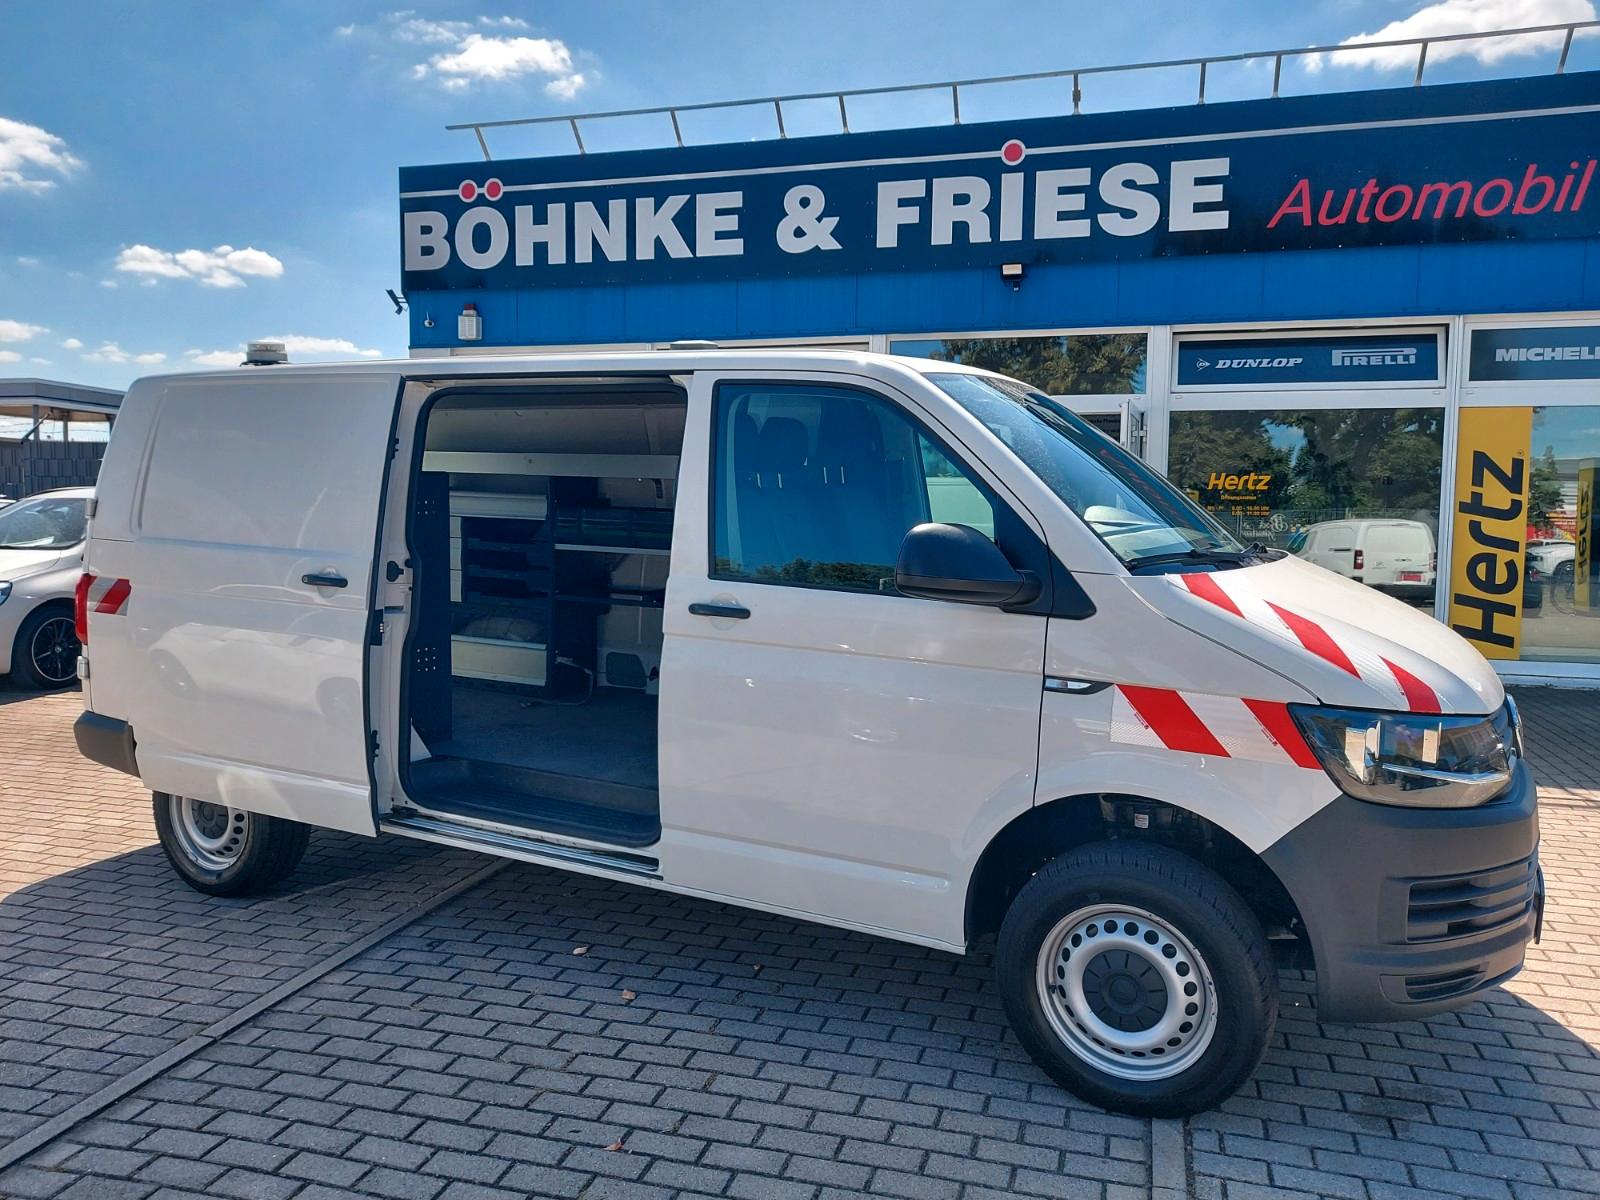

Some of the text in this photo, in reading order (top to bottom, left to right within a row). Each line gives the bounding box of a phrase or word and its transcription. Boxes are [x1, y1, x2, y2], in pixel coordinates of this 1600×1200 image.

[404, 139, 1598, 271] BÖHNKE & FRIESE Automobil
[1215, 357, 1303, 369] DUNLOP
[1331, 348, 1416, 366] PIRELLI
[1207, 472, 1271, 491] Hertz
[1452, 450, 1525, 649] Hertz
